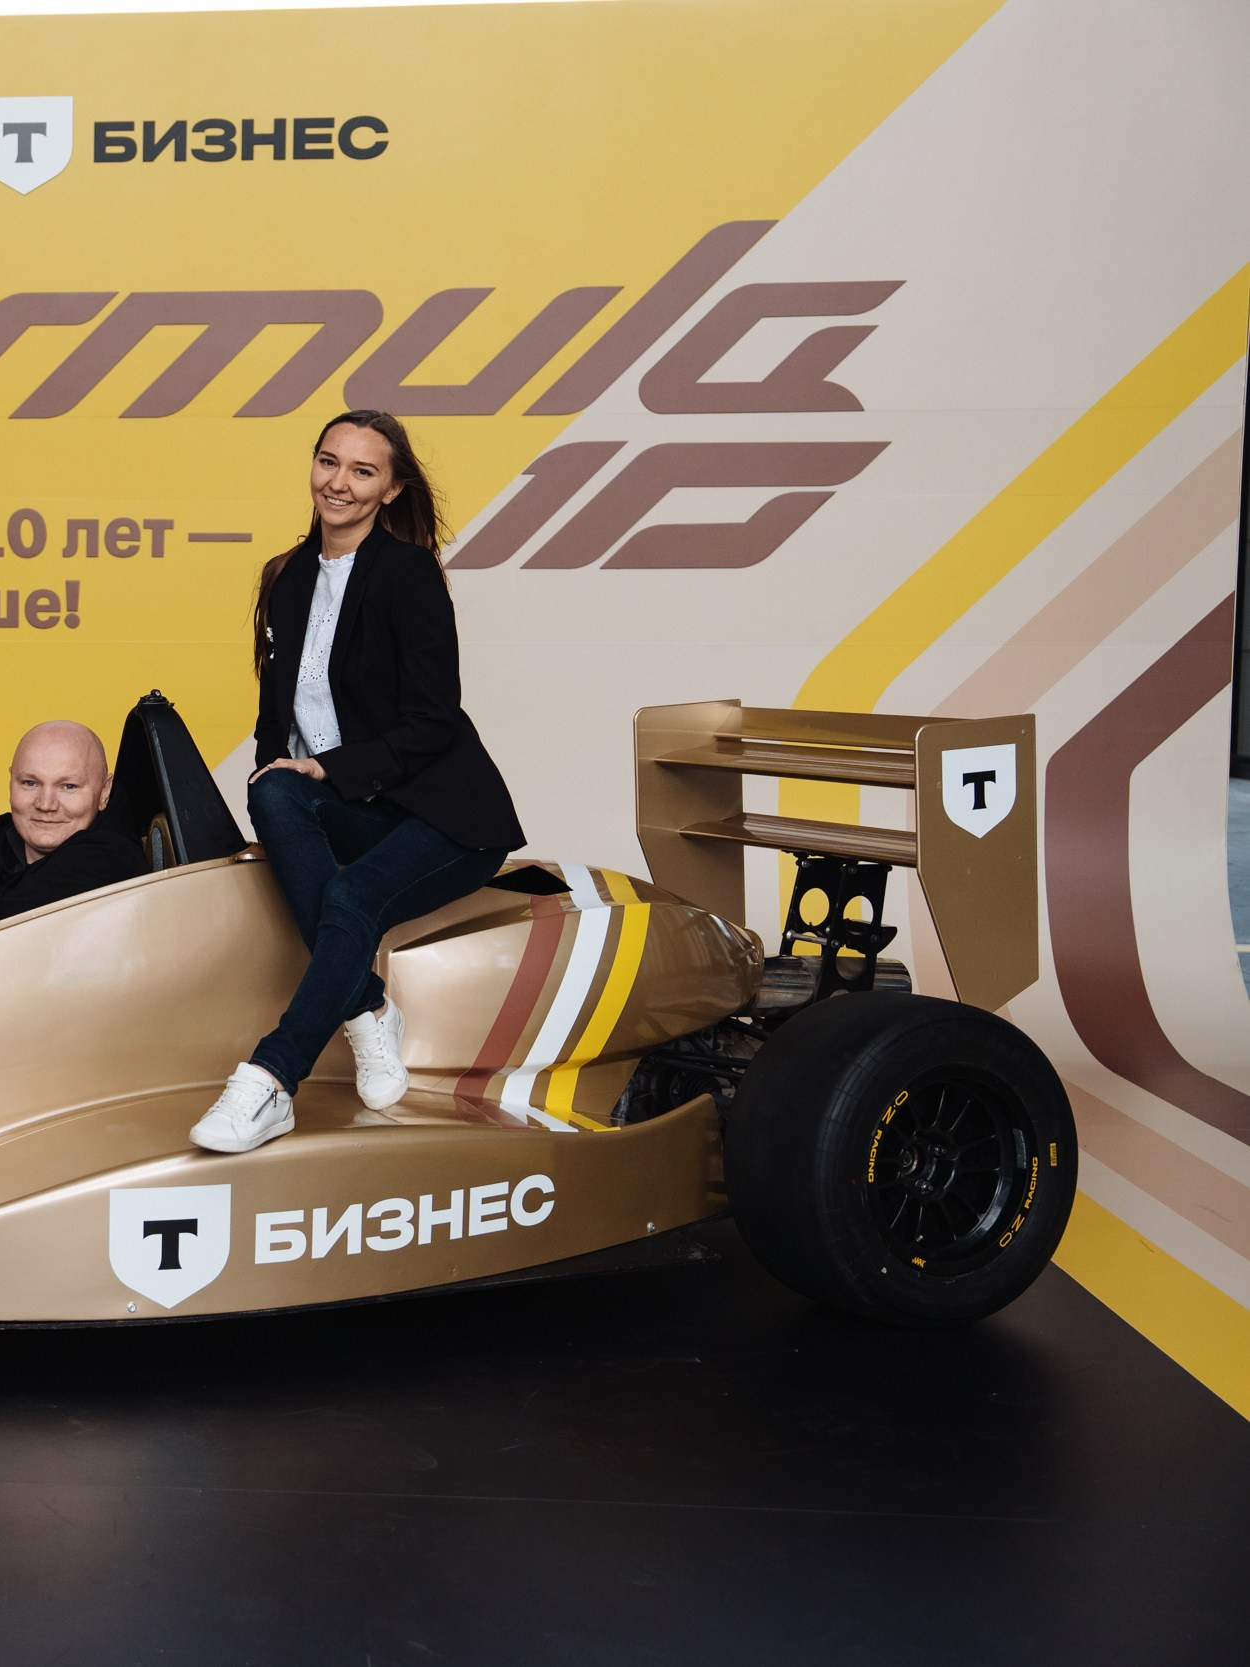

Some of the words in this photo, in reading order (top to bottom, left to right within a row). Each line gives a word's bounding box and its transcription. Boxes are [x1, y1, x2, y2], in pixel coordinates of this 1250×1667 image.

[93, 115, 390, 164] БИЗНЕС
[61, 518, 175, 560] лет
[867, 1129, 883, 1183] RACING
[1023, 1156, 1039, 1209] RACING
[254, 1173, 556, 1265] БИЗНЕС
